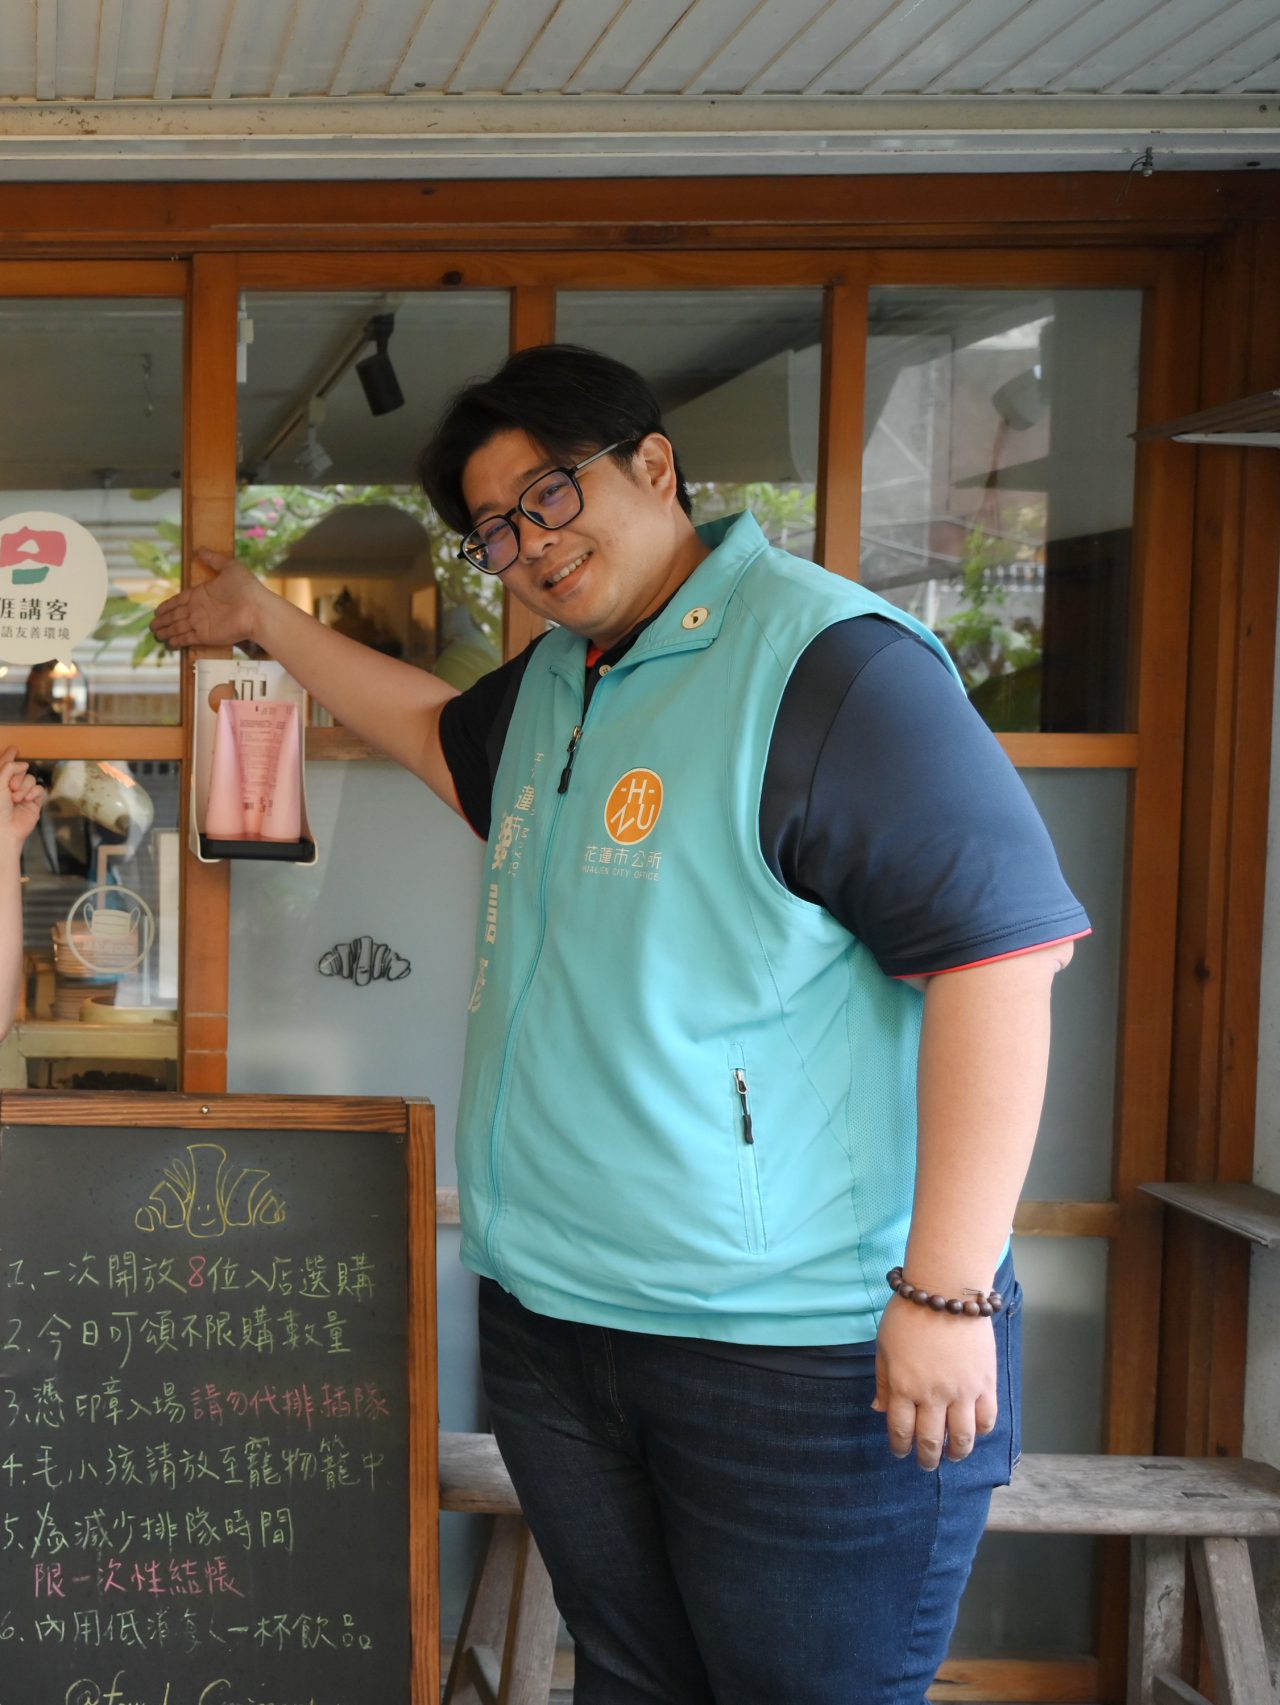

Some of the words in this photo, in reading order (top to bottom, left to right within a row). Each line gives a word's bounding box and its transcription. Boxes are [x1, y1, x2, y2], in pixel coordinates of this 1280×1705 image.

[584, 845, 662, 869] 花蓮市公所
[34, 1556, 246, 1598] 限一次性結帳
